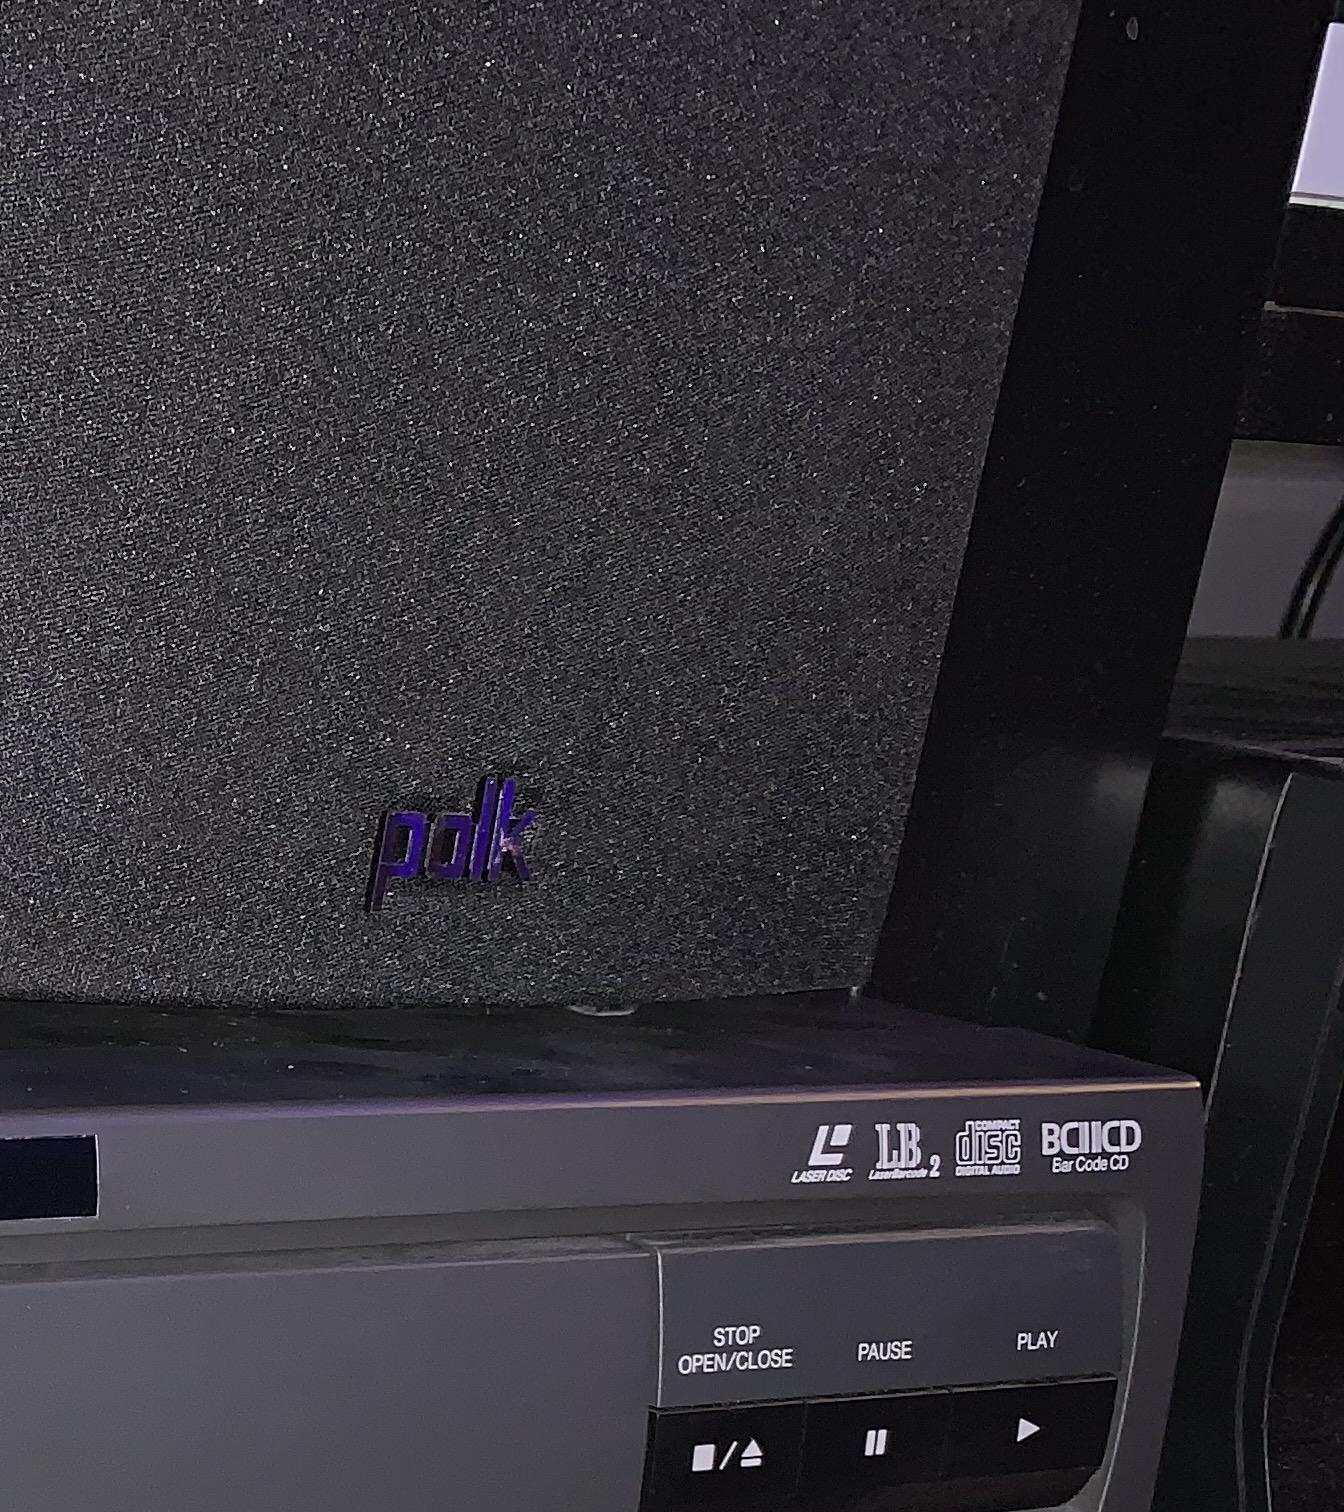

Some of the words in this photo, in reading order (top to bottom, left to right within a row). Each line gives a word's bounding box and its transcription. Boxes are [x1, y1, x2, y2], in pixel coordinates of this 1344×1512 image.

[370, 776, 539, 912] polk
[976, 1119, 1021, 1131] COMPACT
[955, 1121, 1021, 1165] disc
[955, 1165, 990, 1177] DIGITAL
[991, 1163, 1021, 1176] AUDIO
[1075, 1155, 1108, 1172] Code
[1110, 1154, 1129, 1171] CD
[791, 1169, 823, 1184] LASER
[824, 1167, 853, 1182] DISC
[713, 1325, 761, 1347] STOP
[1017, 1331, 1059, 1351] PLAY
[678, 1348, 794, 1374] OPEN/CLOSE
[858, 1341, 912, 1361] PAUSE
